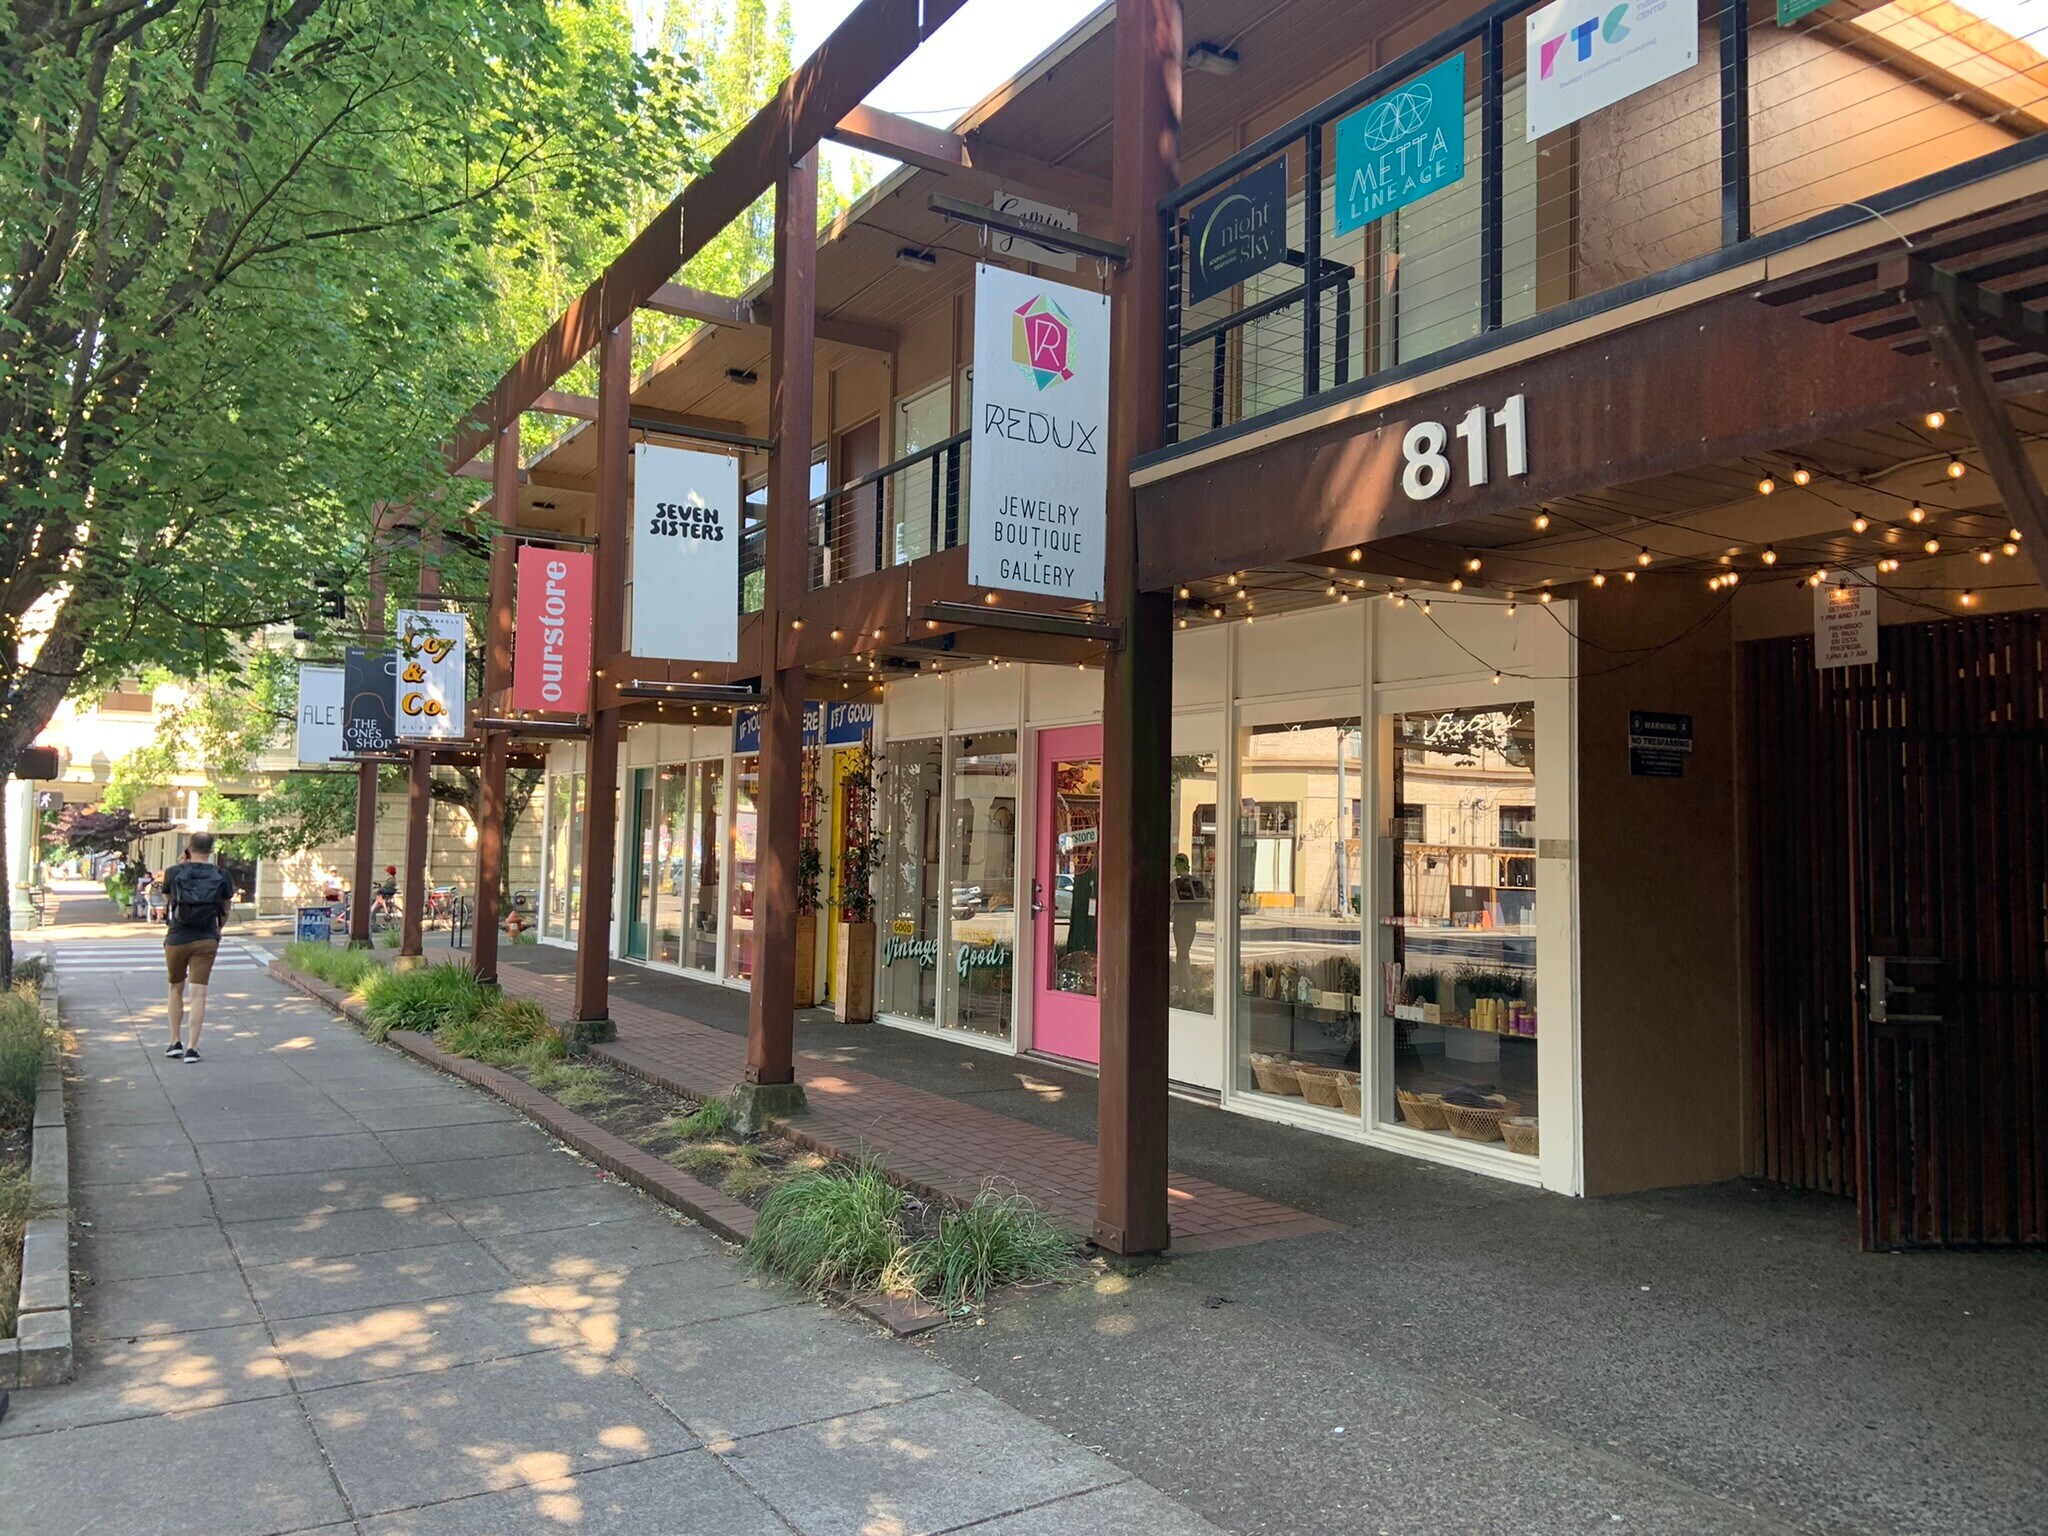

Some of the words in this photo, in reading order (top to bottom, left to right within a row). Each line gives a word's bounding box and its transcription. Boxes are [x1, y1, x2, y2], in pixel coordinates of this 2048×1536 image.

[1637, 1, 1668, 21] CENTER
[1349, 127, 1449, 202] METTA
[1221, 202, 1271, 248] night
[1240, 234, 1270, 262] sky
[984, 402, 1099, 456] REDUX
[1402, 393, 1528, 501] 811
[655, 502, 719, 525] SEVEN
[998, 495, 1080, 527] JEWELRY
[649, 518, 725, 542] SISTERS
[993, 520, 1083, 554] BOUTIQUE
[999, 557, 1076, 588] GALLERY
[1828, 603, 1860, 614] BETWEEN
[1837, 611, 1853, 619] AND
[1860, 608, 1872, 616] AM
[538, 560, 568, 703] ourstore
[1831, 638, 1840, 646] EN
[1832, 631, 1839, 639] EL
[1841, 629, 1859, 637] PASO
[402, 632, 458, 664] Coy
[1856, 649, 1868, 657] AM
[402, 661, 427, 684] &
[401, 691, 448, 717] Co.
[847, 703, 873, 725] GOOD
[347, 727, 382, 739] ONES
[352, 718, 378, 729] THE
[739, 721, 747, 741] IF
[1644, 721, 1677, 731] WARNING
[355, 737, 392, 749] SHOP
[1631, 736, 1642, 745] NO
[1643, 737, 1690, 748] TRESPASSING
[893, 923, 912, 933] GOOD
[885, 935, 939, 967] Vintage
[956, 941, 1010, 978] Goods
